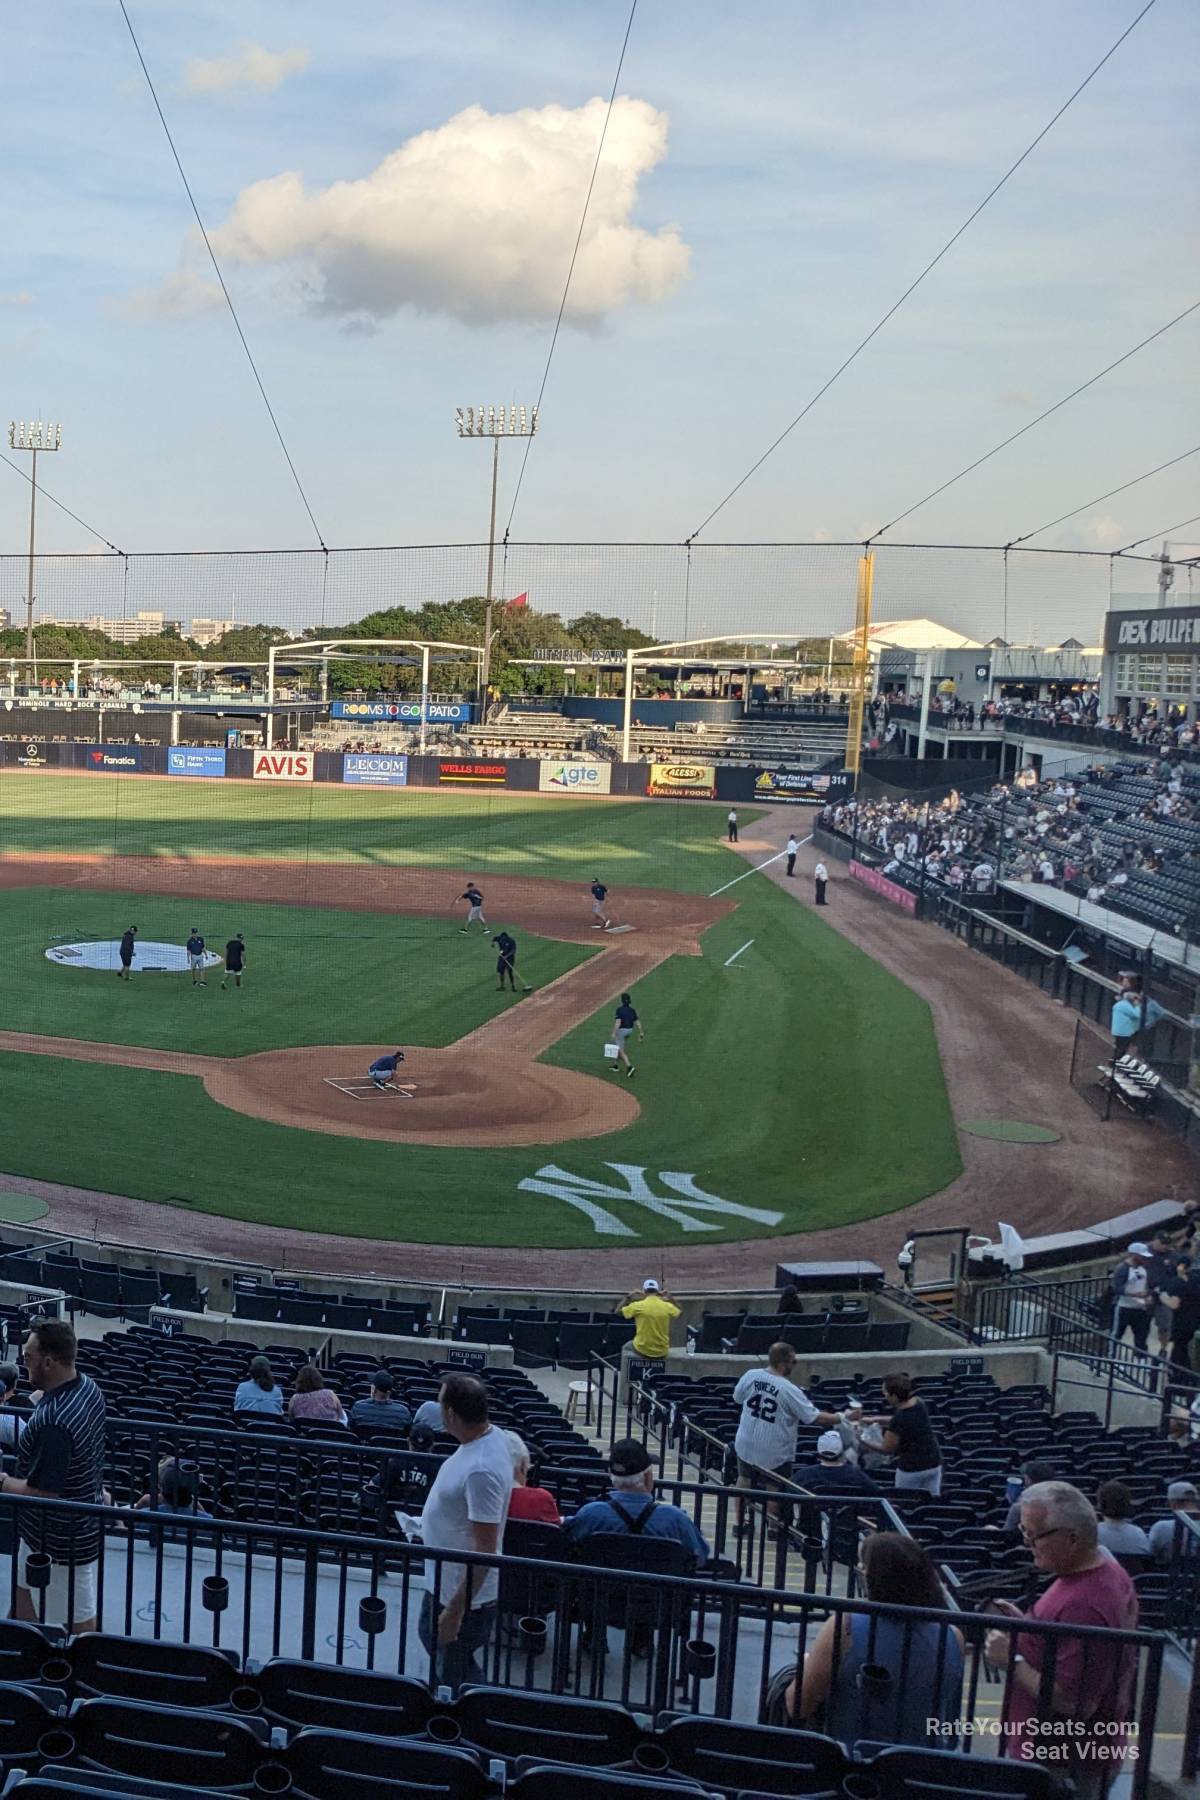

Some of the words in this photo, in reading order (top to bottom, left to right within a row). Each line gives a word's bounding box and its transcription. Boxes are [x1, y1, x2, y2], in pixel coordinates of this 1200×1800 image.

[1118, 620, 1149, 644] DEX
[342, 703, 383, 715] ROOMS
[385, 705, 399, 715] TO
[401, 705, 420, 716] GO
[429, 706, 460, 717] PATIO
[104, 756, 135, 765] Fanatics
[256, 756, 308, 775] AVIS
[347, 759, 404, 771] LECOM
[440, 764, 472, 773] WELLS
[474, 765, 506, 774] FARGO
[569, 766, 598, 783] gte
[831, 776, 846, 784] 314
[653, 788, 687, 796] ITALIAN
[689, 789, 711, 797] FOODS
[162, 1323, 172, 1337] M
[642, 1367, 652, 1380] K
[753, 1379, 780, 1398] RIVERA
[746, 1393, 778, 1424] 42
[400, 1470, 428, 1486] JTER
